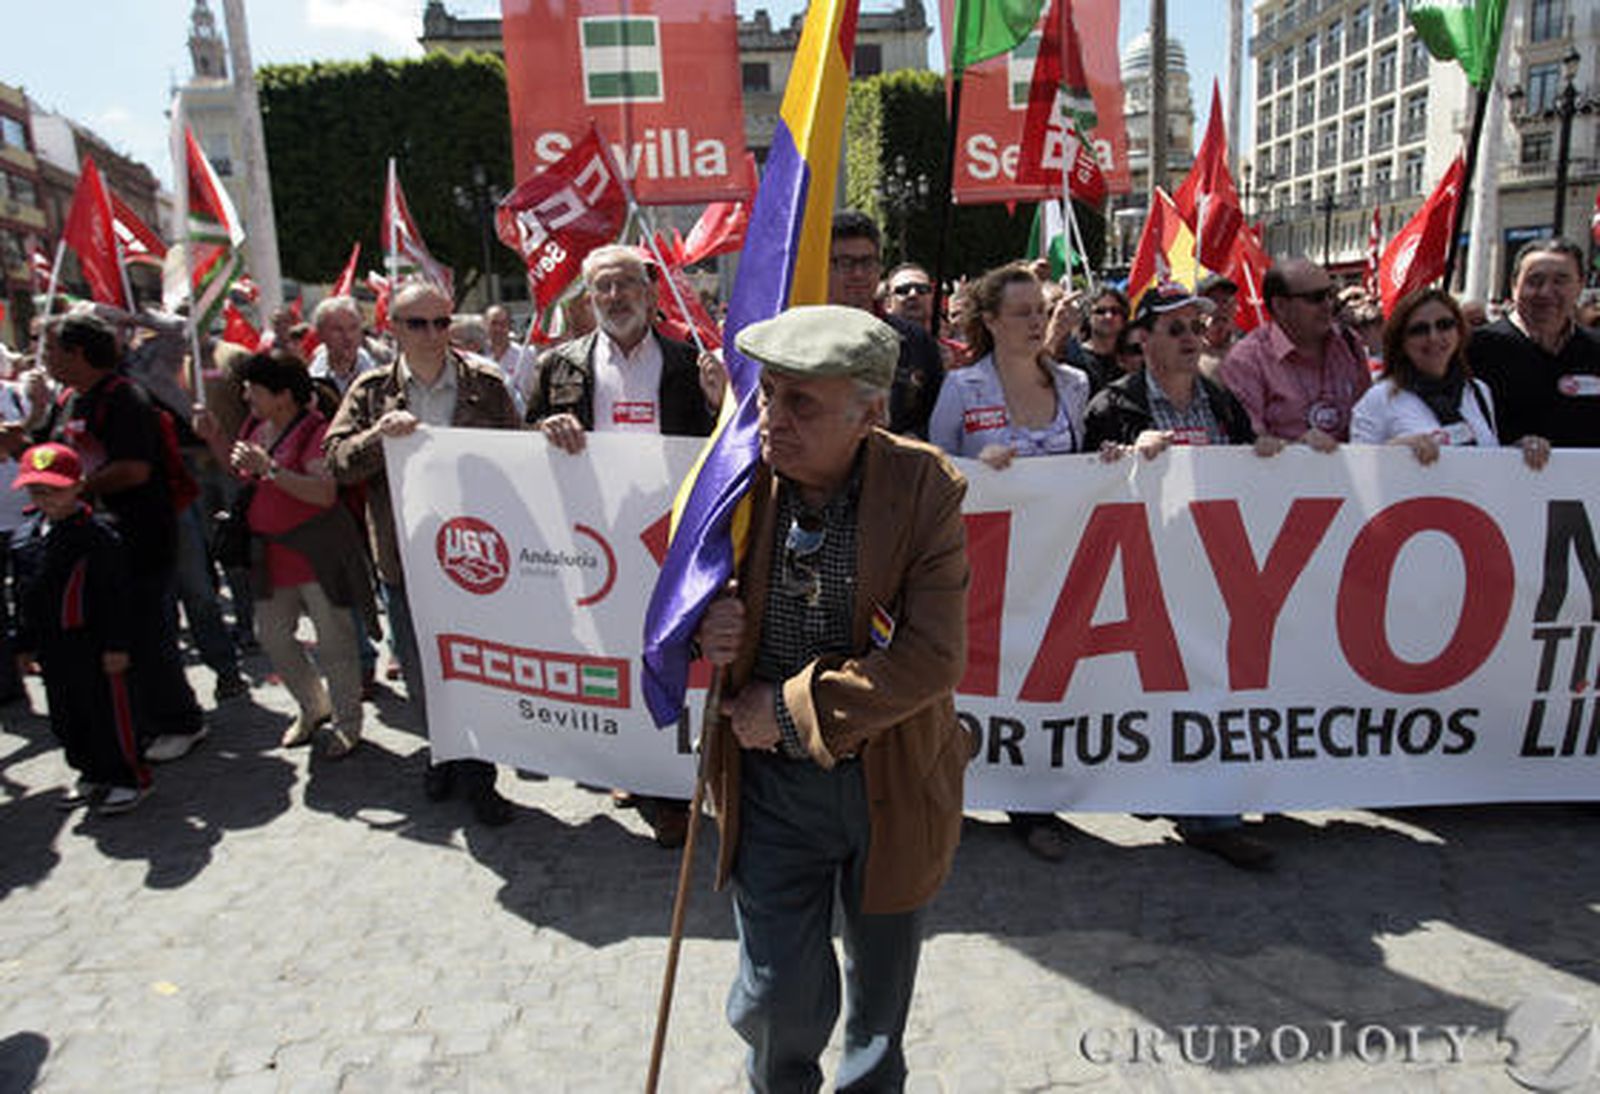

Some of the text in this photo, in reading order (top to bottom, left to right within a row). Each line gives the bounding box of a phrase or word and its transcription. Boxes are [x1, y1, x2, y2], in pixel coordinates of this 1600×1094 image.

[534, 128, 728, 180] Svilla
[445, 527, 499, 563] UGT
[955, 495, 1517, 703] AYO
[450, 640, 579, 697] CCOO
[518, 698, 620, 737] Sevilla
[1042, 709, 1151, 768] TUS
[1171, 705, 1481, 765] DERECHOS
